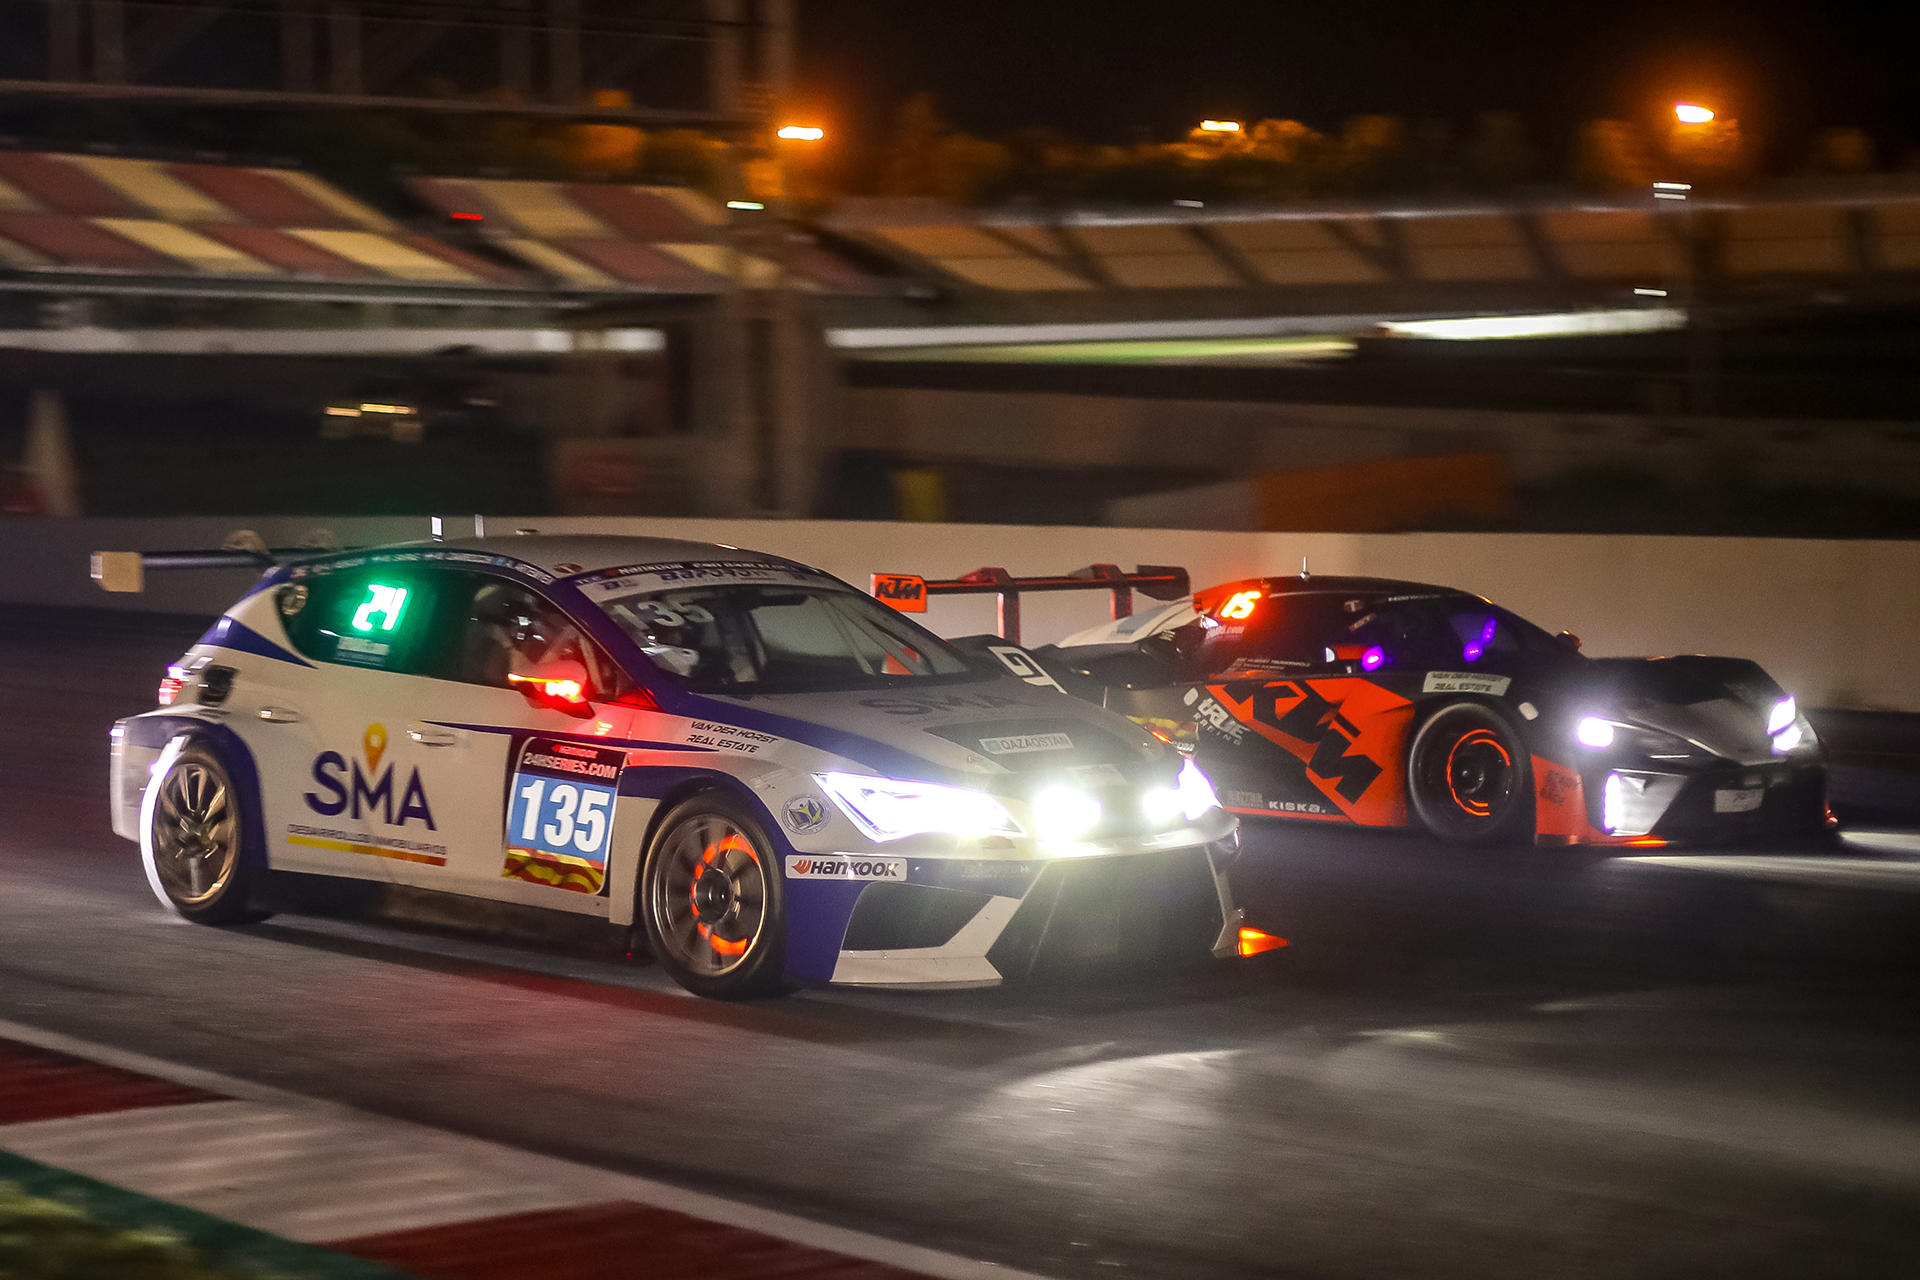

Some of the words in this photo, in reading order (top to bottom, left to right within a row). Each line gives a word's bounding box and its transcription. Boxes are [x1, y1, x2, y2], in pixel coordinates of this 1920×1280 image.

[875, 577, 922, 600] KTM
[606, 593, 715, 632] 135
[1220, 591, 1262, 618] 15
[686, 734, 715, 746] REAL
[717, 739, 760, 753] ESTATE
[691, 721, 713, 730] VAN
[713, 726, 738, 735] DER
[736, 730, 779, 744] HORST
[1000, 734, 1069, 750] QAZAQSTAN
[1223, 680, 1383, 804] KTM
[523, 752, 618, 779] 24HSERIES.COM
[303, 750, 437, 831] SMA
[521, 780, 611, 853] 135
